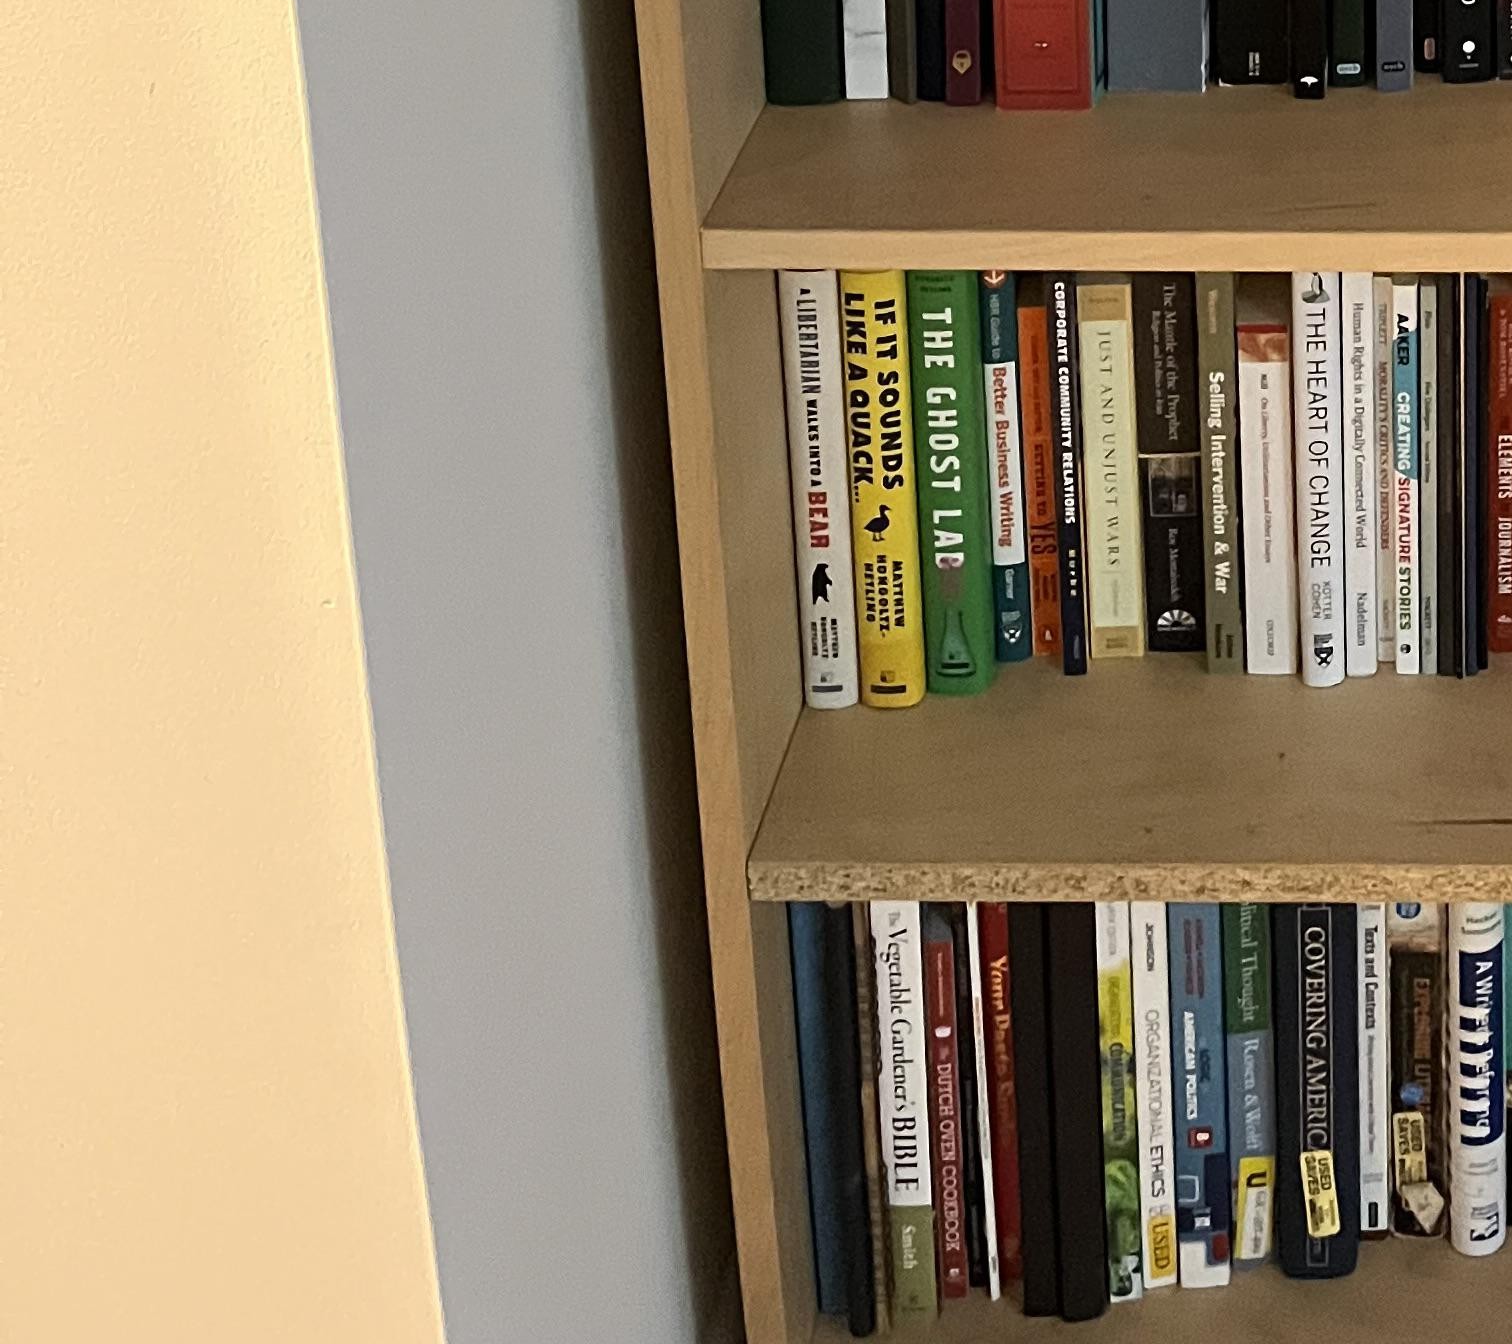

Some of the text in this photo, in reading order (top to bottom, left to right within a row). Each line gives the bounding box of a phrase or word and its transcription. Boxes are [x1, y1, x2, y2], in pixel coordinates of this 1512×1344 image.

[796, 300, 821, 394] LIBERTARIAN
[807, 400, 821, 441] WALKS
[844, 292, 874, 503] LIKE A QUACK...
[874, 299, 904, 490] IF IT SOUNDS
[922, 308, 965, 568] THE GHOST LAB
[1055, 282, 1075, 523] CORPORATE COMMUNITY RELATIONS
[1306, 308, 1331, 568] THE HEART OF CHANGE
[808, 492, 829, 548] BEAR
[809, 446, 822, 476] INTO
[992, 367, 1014, 547] Better Business Writing
[1098, 330, 1121, 566] JUST AND UNJUST WARS
[1208, 372, 1229, 593] Selling Intervention & War
[881, 928, 918, 1191] Vegetable Gardener's BIBLE
[1305, 926, 1325, 1049] COVERING
[902, 1225, 917, 1269] Smith
[1152, 1222, 1169, 1269] USED
